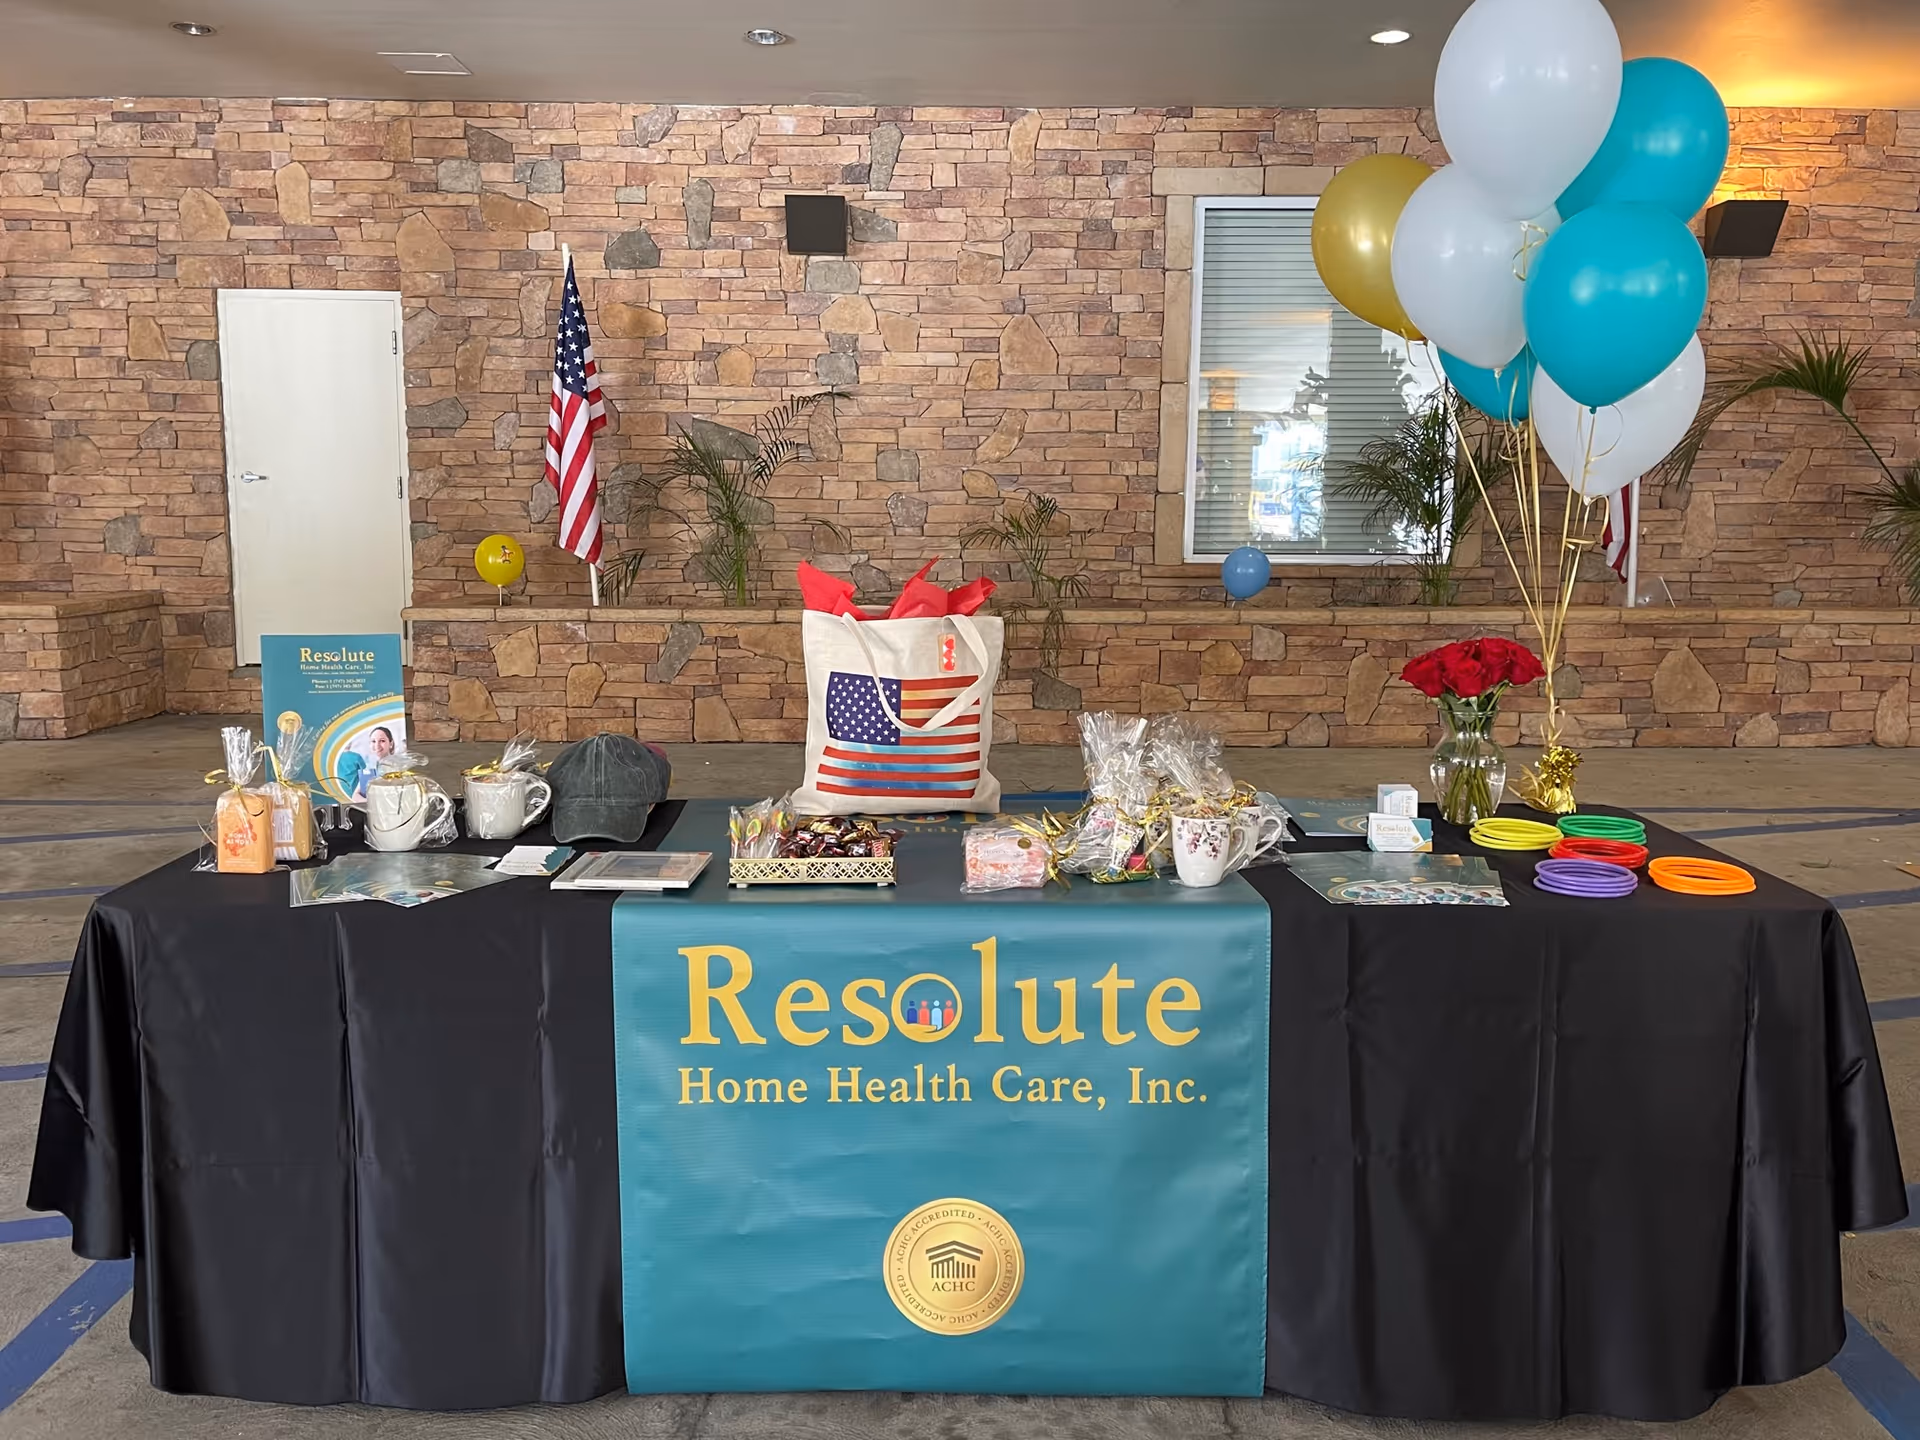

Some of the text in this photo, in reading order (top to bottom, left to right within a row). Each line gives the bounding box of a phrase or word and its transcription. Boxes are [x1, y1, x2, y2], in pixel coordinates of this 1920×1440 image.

[300, 647, 375, 662] Resolute
[677, 936, 1201, 1046] Resolute
[678, 1063, 1208, 1110] Home Health Care, Inc.
[896, 1209, 976, 1262] ACHC ACCREDITED
[931, 1281, 976, 1292] ACHC
[983, 1220, 1014, 1311] ACHC ACCREDITED
[896, 1274, 981, 1324] ACHC ACCREDITED
